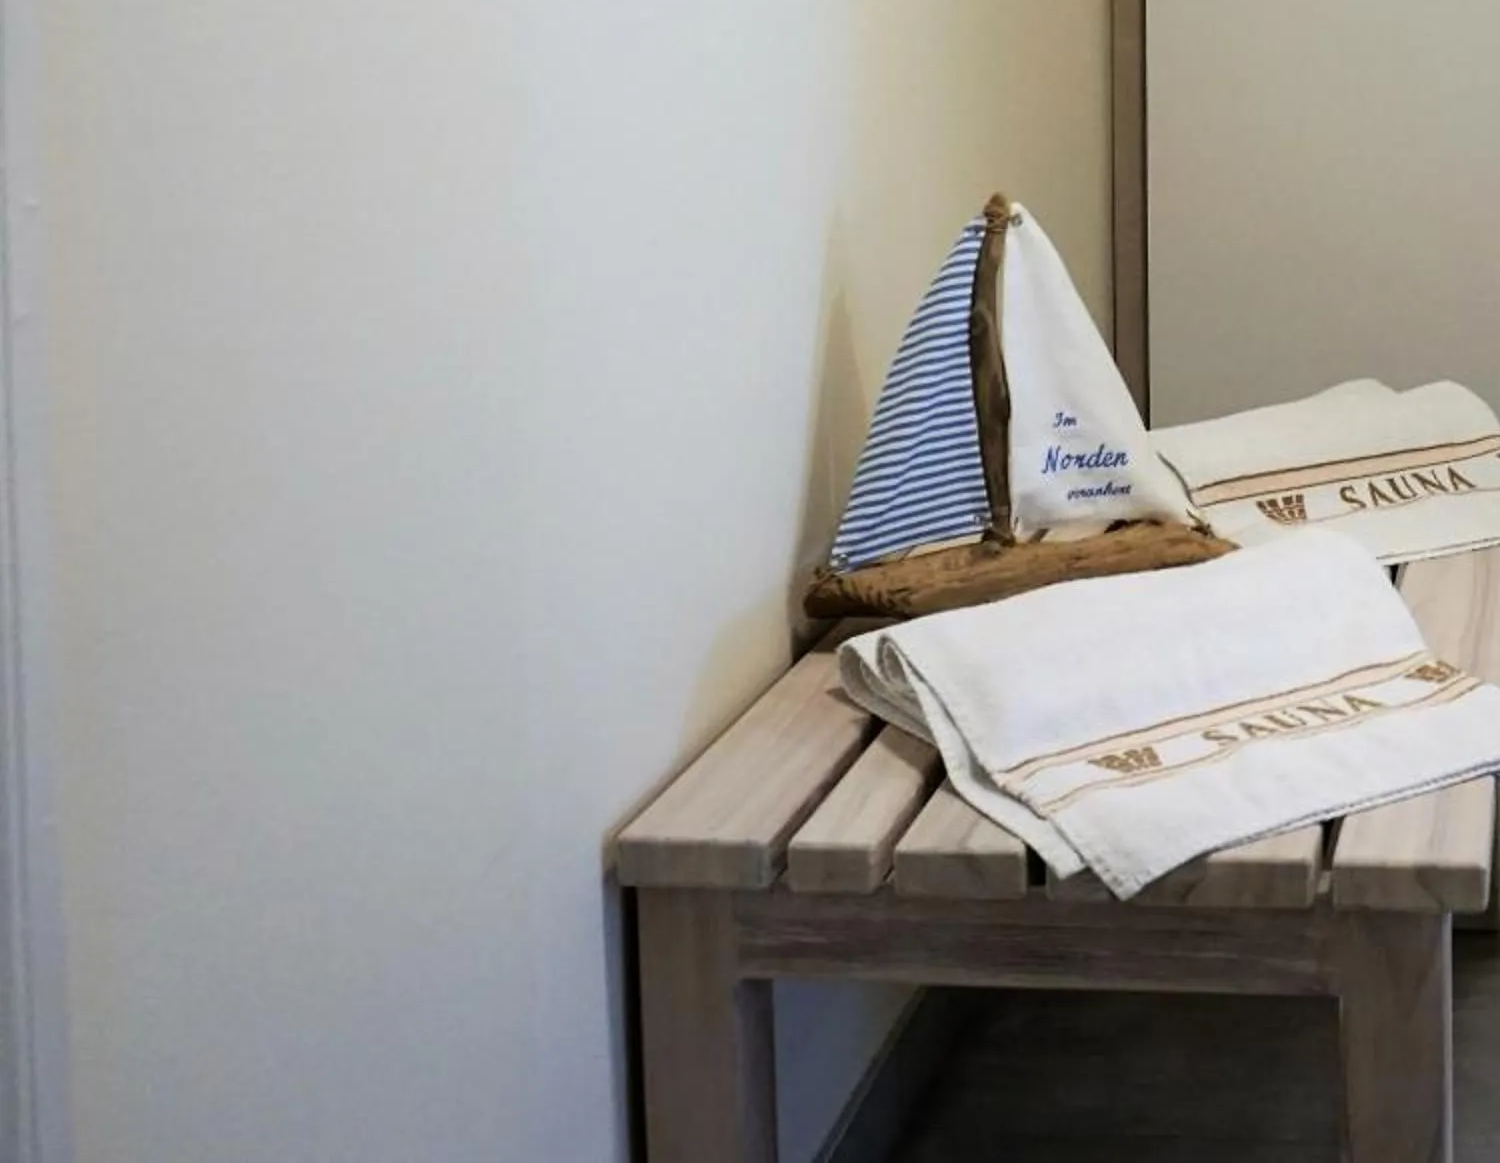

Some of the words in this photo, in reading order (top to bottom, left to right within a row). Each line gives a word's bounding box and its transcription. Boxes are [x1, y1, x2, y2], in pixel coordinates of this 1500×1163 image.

[1053, 412, 1077, 428] Im
[1041, 443, 1129, 474] Norden
[1339, 466, 1477, 512] SAUNA
[1202, 692, 1390, 748] SAUNA
